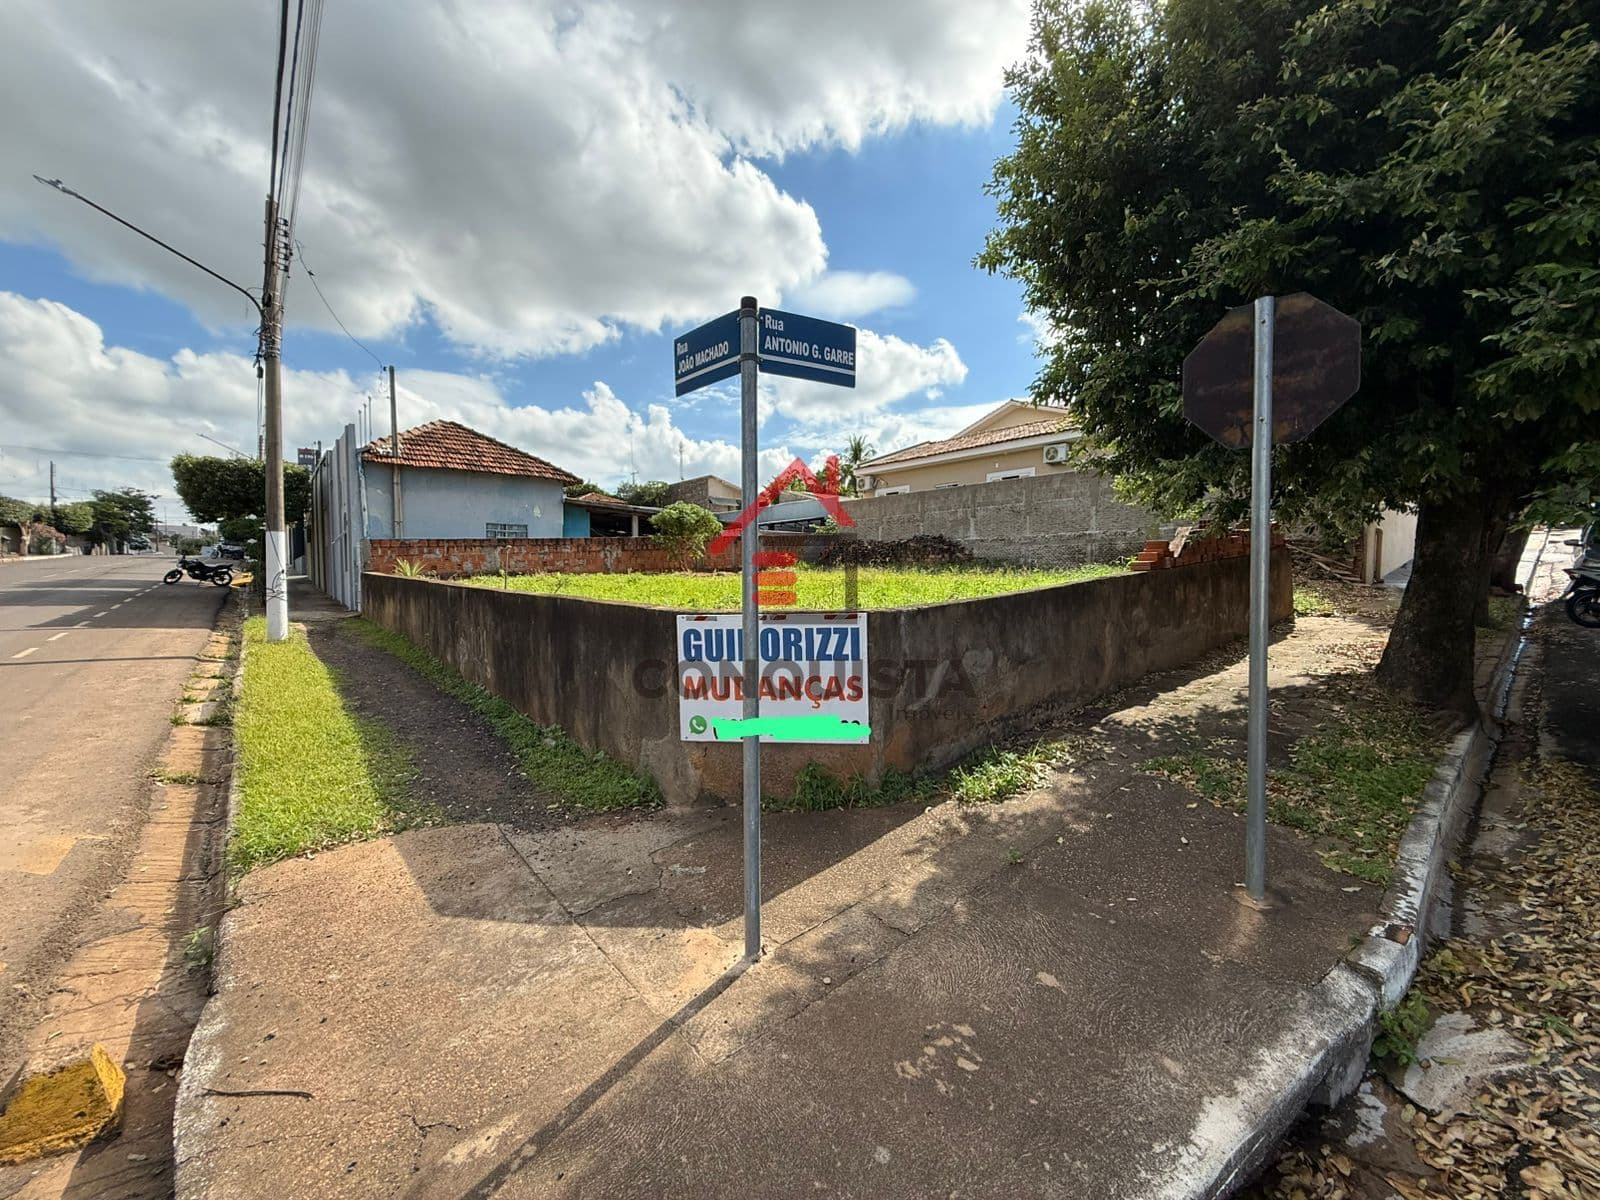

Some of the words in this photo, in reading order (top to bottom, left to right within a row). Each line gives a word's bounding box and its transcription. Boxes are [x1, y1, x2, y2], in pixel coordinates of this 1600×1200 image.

[765, 314, 784, 331] Rua
[677, 342, 689, 356] Rua
[678, 355, 695, 375] JOÃO
[695, 340, 729, 367] MACHADO
[764, 335, 810, 356] ANTONIO
[812, 344, 822, 359] G.
[824, 347, 854, 366] GARRE
[683, 627, 860, 662] GUIORIZZI
